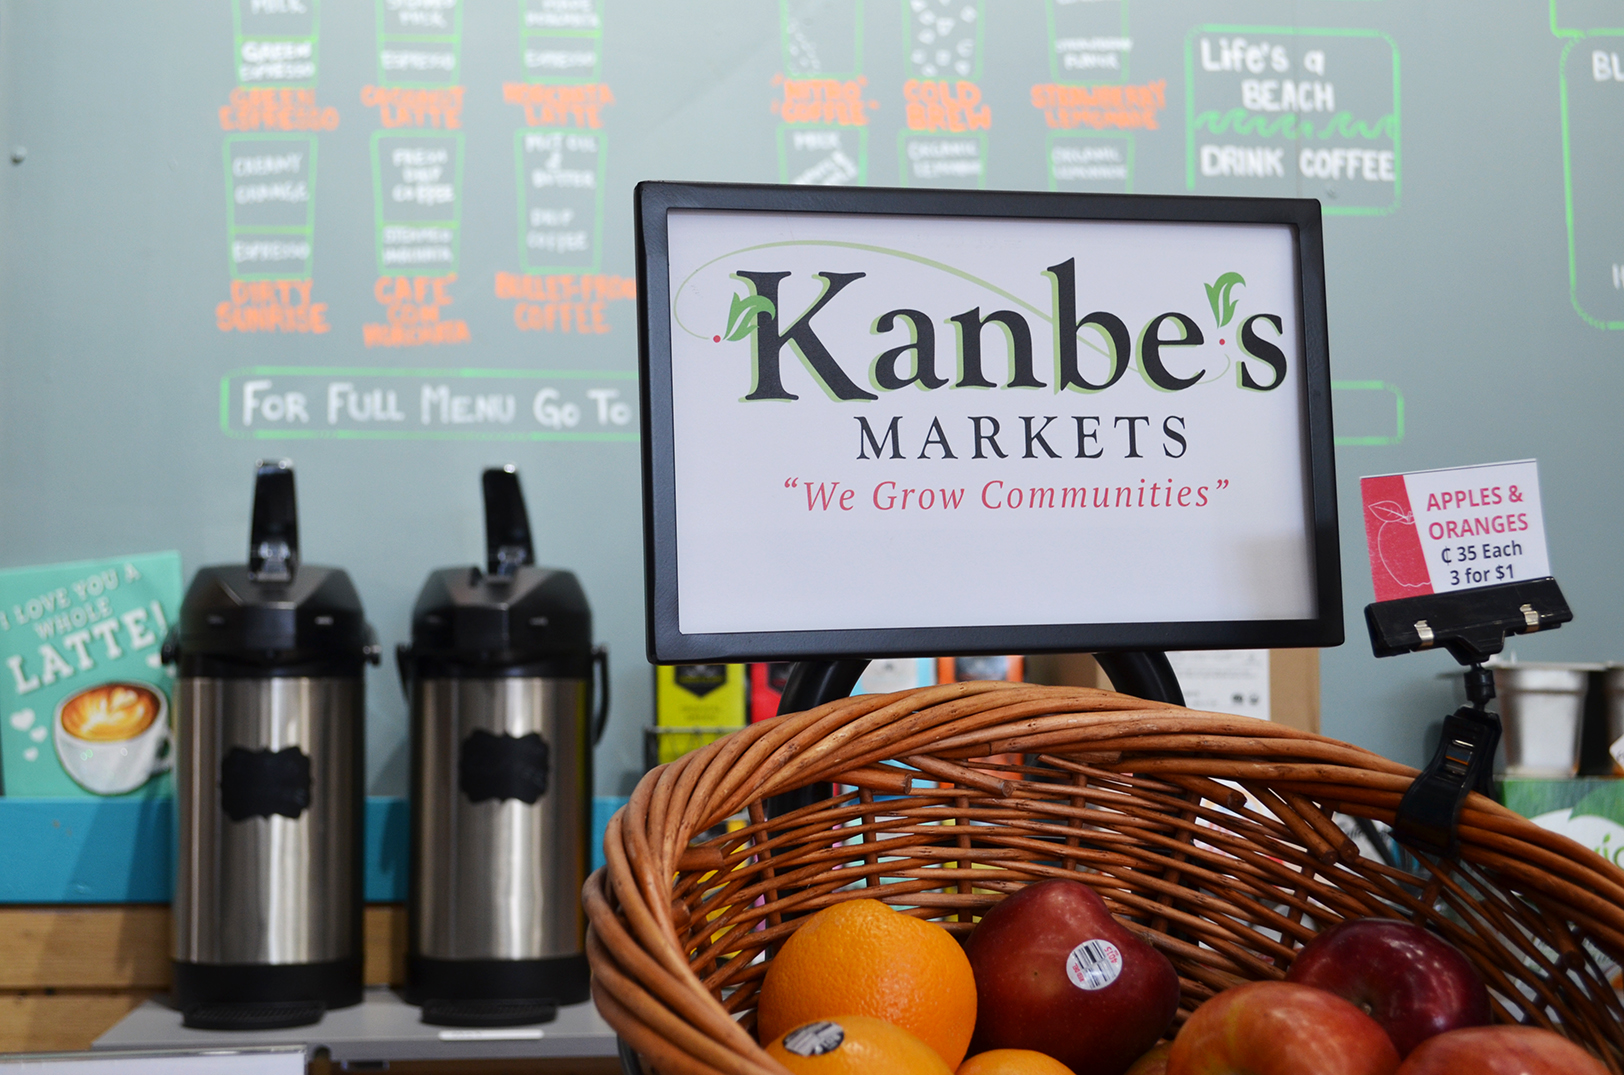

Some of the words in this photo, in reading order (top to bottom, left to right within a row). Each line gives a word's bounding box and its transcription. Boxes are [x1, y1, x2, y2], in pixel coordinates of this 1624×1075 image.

[1200, 37, 1290, 73] Life's
[903, 79, 982, 107] COLD
[1241, 78, 1336, 113] BEACH
[906, 102, 992, 132] BREW
[1200, 144, 1285, 179] DRINK
[1299, 148, 1397, 182] COFFEE
[230, 278, 313, 305] DIRTY
[215, 302, 331, 334] SUNRISE
[513, 300, 612, 334] COFFEE
[728, 256, 1289, 403] Kanbe's
[327, 381, 406, 427] FULL
[420, 384, 517, 426] MENU
[855, 414, 1189, 460] MARKETS
[872, 479, 967, 511] Grow
[1426, 486, 1502, 512] APPLES
[1508, 484, 1524, 502] &
[1428, 512, 1529, 540] ORANGES
[1457, 545, 1477, 562] 35
[1482, 540, 1523, 560] Each
[1450, 570, 1460, 586] 3
[1464, 567, 1490, 584] for
[1495, 564, 1515, 580] $1
[13, 587, 71, 626] LOVE
[72, 568, 119, 602] YOU
[123, 562, 141, 584] A
[33, 596, 113, 640] WHOLE
[6, 600, 169, 695] LATTE!
[1104, 946, 1117, 963] 4015
